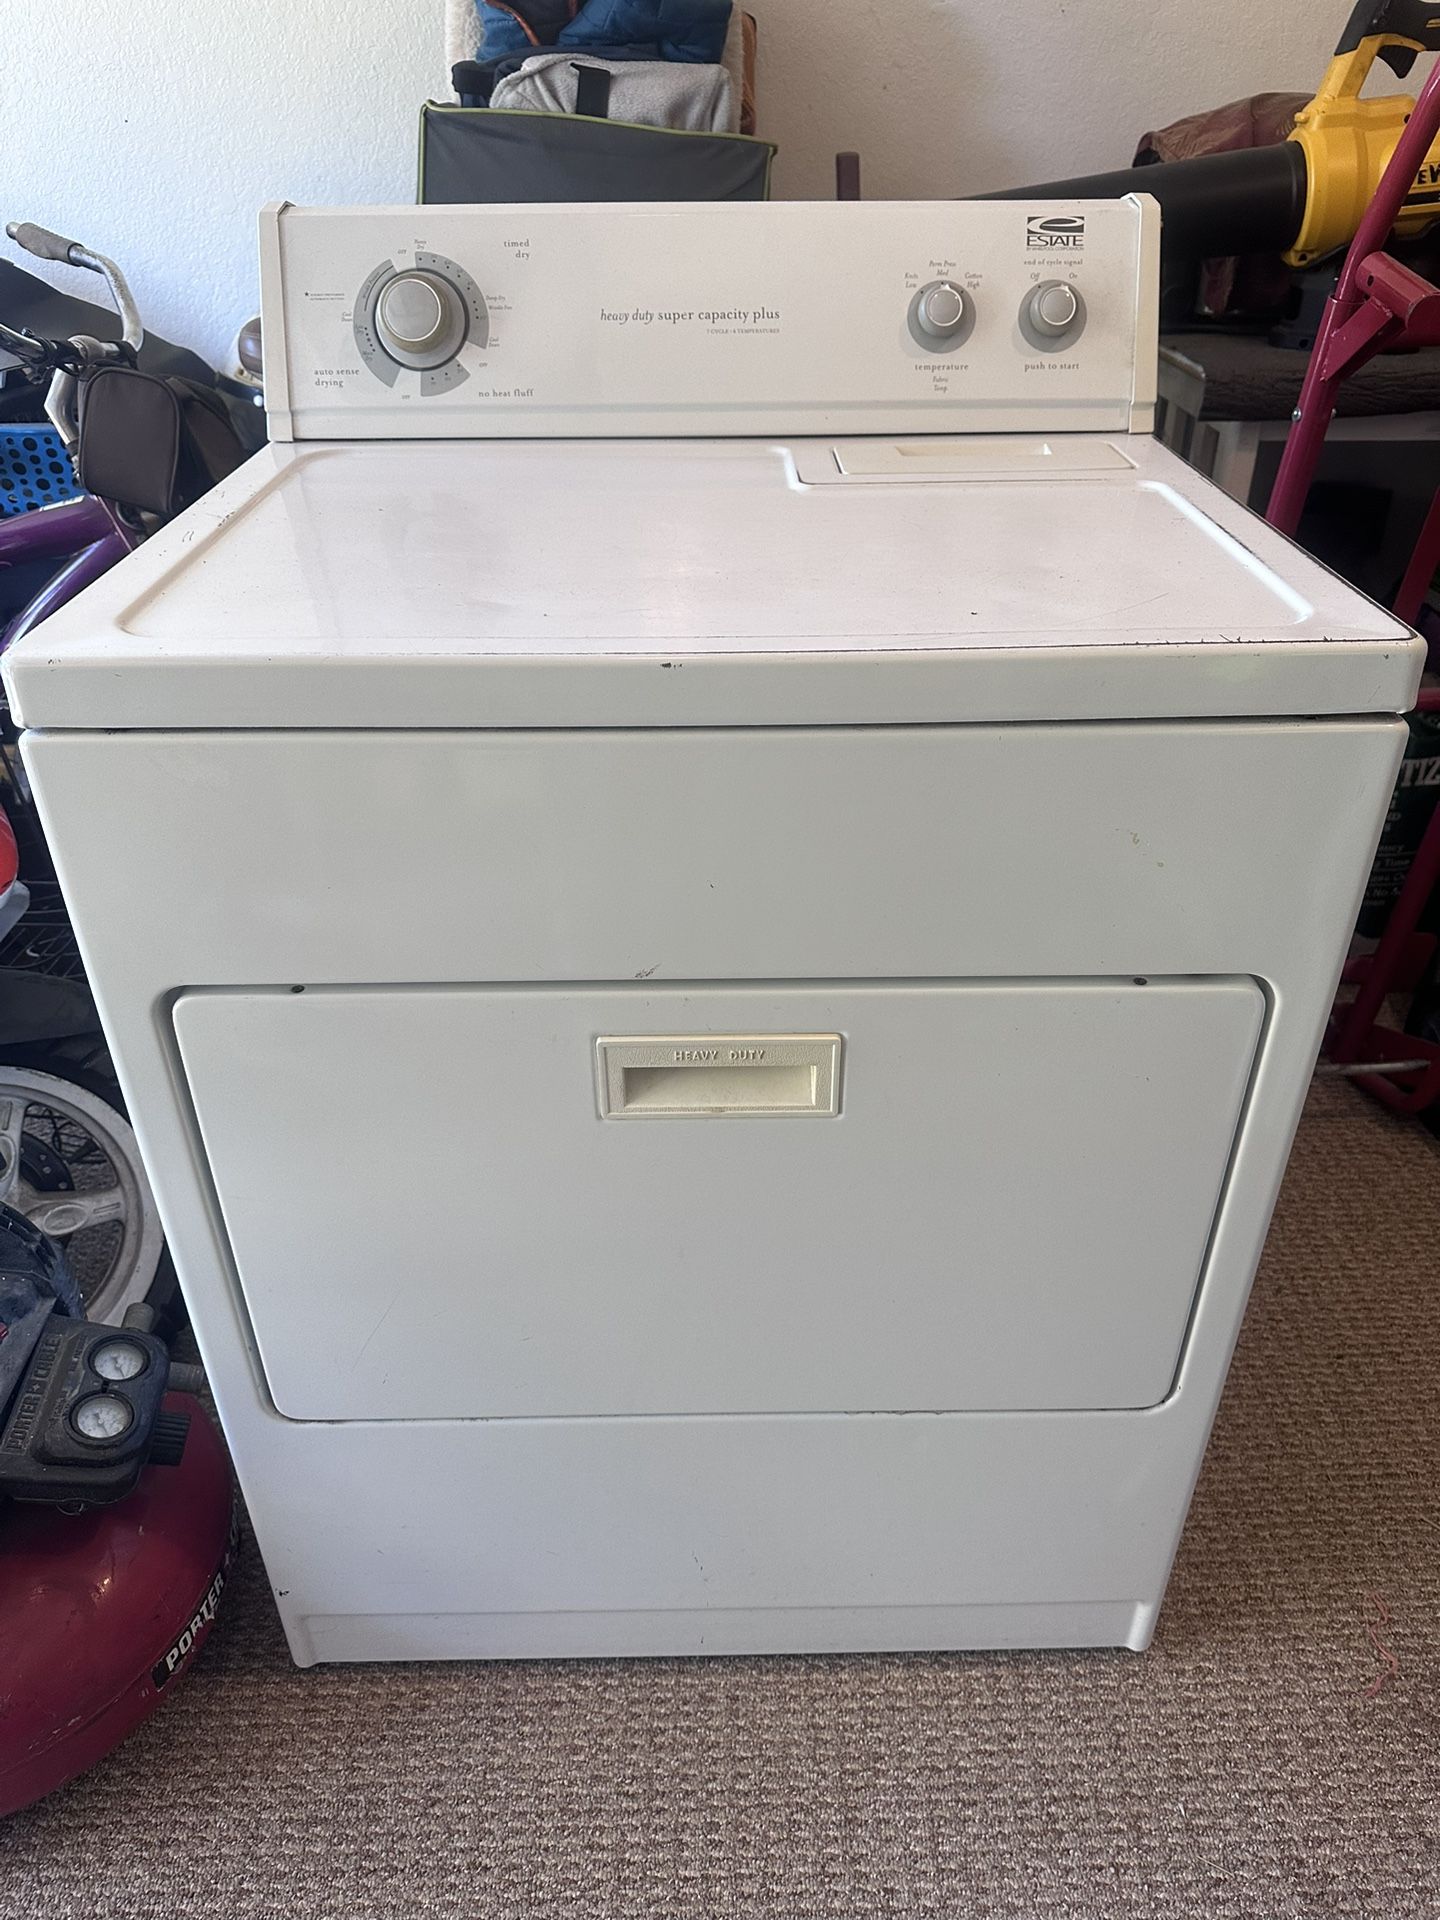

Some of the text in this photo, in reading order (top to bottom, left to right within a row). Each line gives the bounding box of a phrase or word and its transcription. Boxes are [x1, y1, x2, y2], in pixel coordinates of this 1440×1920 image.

[503, 239, 530, 247] timed
[1026, 234, 1084, 246] ESTATE
[515, 250, 530, 260] dry
[1046, 258, 1062, 266] cycle
[1063, 258, 1083, 267] signal
[1030, 272, 1078, 281] Off On
[600, 306, 781, 325] heavy duty super capacity plus
[914, 363, 969, 373] temperature
[1024, 361, 1080, 372] push to start
[314, 368, 360, 376] auto sense
[314, 378, 344, 388] drying
[492, 389, 511, 397] heat
[513, 388, 534, 397] fluff
[674, 1049, 765, 1061] HEAVY DUTY
[6, 1394, 40, 1449] PORTER
[165, 1571, 224, 1672] PORTER
